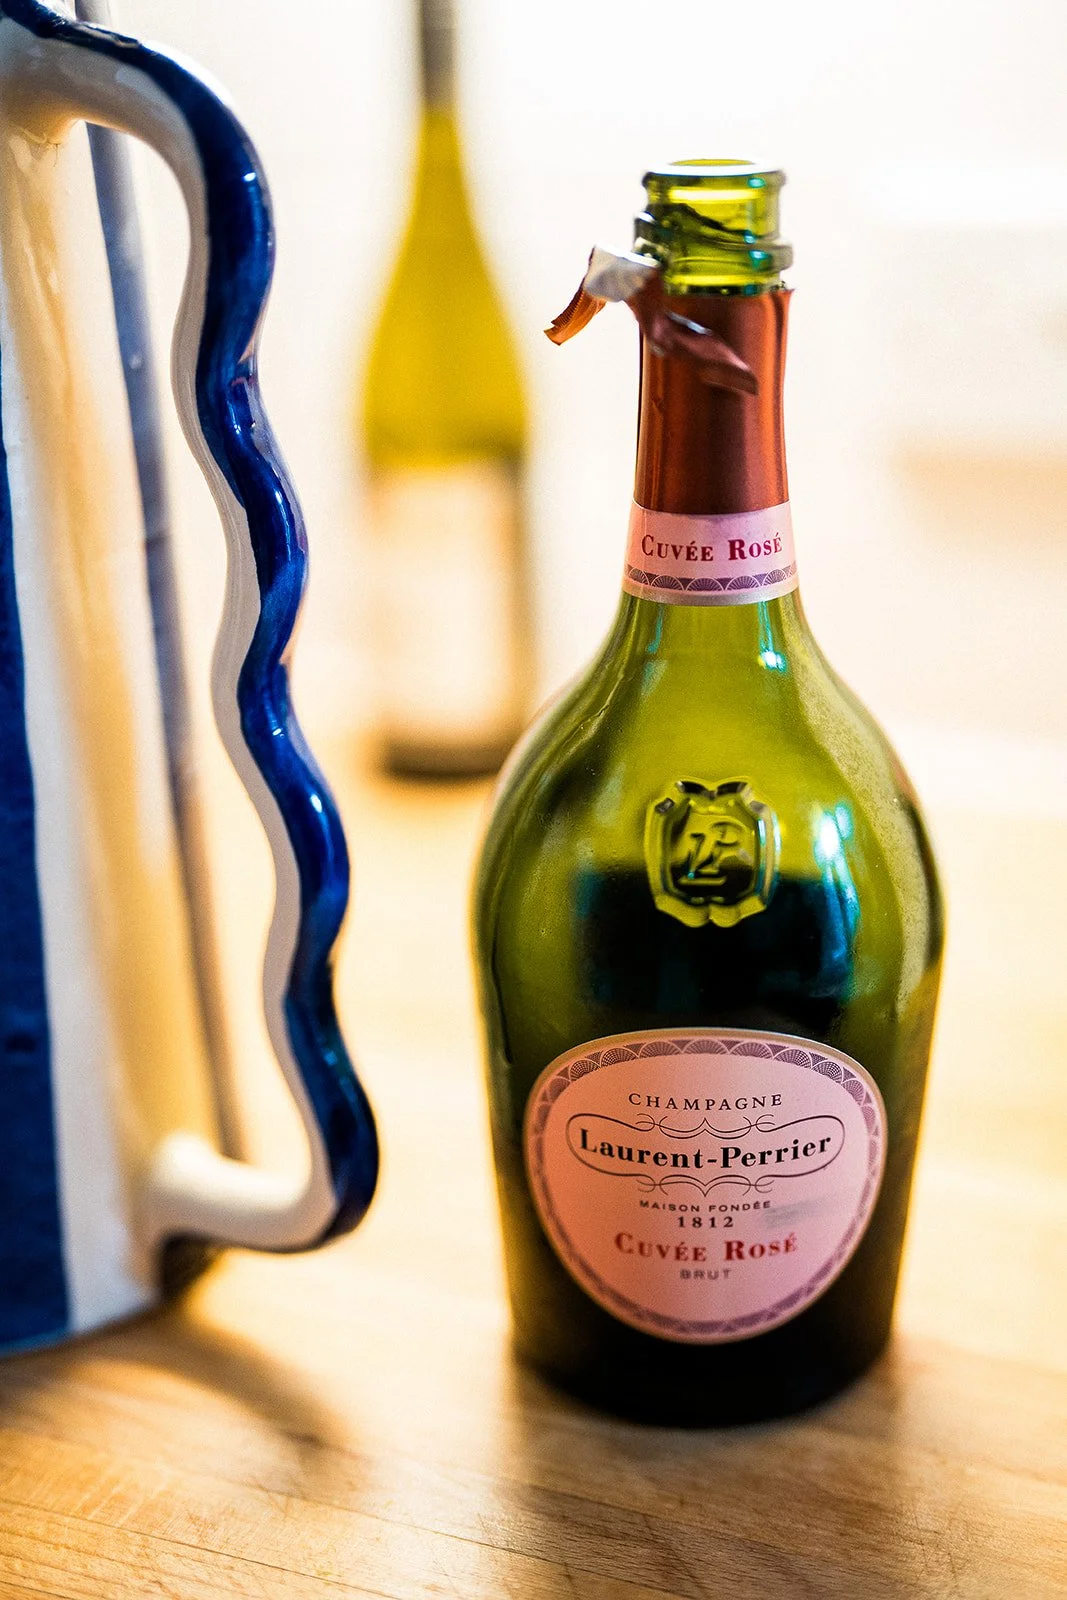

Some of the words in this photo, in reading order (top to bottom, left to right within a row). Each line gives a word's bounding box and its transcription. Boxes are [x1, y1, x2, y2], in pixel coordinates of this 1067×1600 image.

[641, 534, 714, 562] CUVÉE
[727, 532, 783, 561] ROSÉ
[628, 1093, 783, 1111] CHAMPAGNE
[579, 1128, 832, 1169] Laurent-Perrier
[639, 1200, 701, 1213] MAISON
[708, 1200, 772, 1213] FONDÉE
[677, 1216, 735, 1229] 1812
[614, 1232, 707, 1263] CUVÉE
[723, 1232, 798, 1262] ROSÉ
[679, 1268, 732, 1281] BRUT
